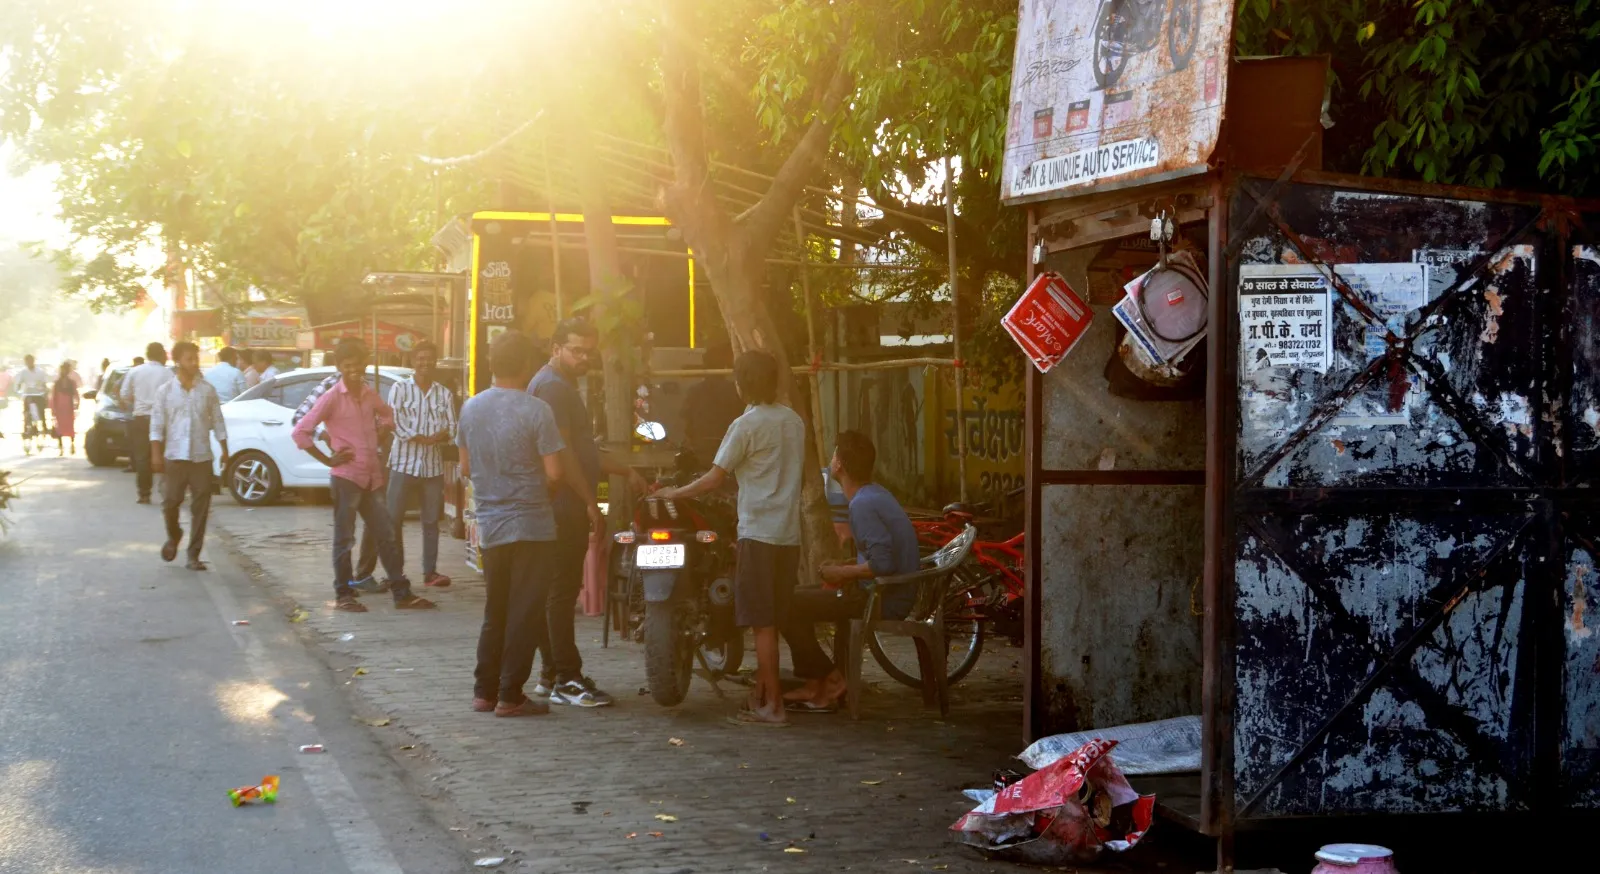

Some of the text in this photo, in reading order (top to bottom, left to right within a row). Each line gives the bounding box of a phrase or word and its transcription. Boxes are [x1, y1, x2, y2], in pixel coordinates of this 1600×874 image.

[1039, 164, 1046, 187] &
[1049, 155, 1081, 185] UNIQUE
[1081, 148, 1110, 177] AUTO
[1111, 139, 1156, 171] SERVICE
[482, 261, 511, 278] SAB
[1243, 279, 1316, 290] 30 साल से सेवार
[1020, 310, 1057, 344] Mark
[1299, 319, 1322, 338] वर्मा
